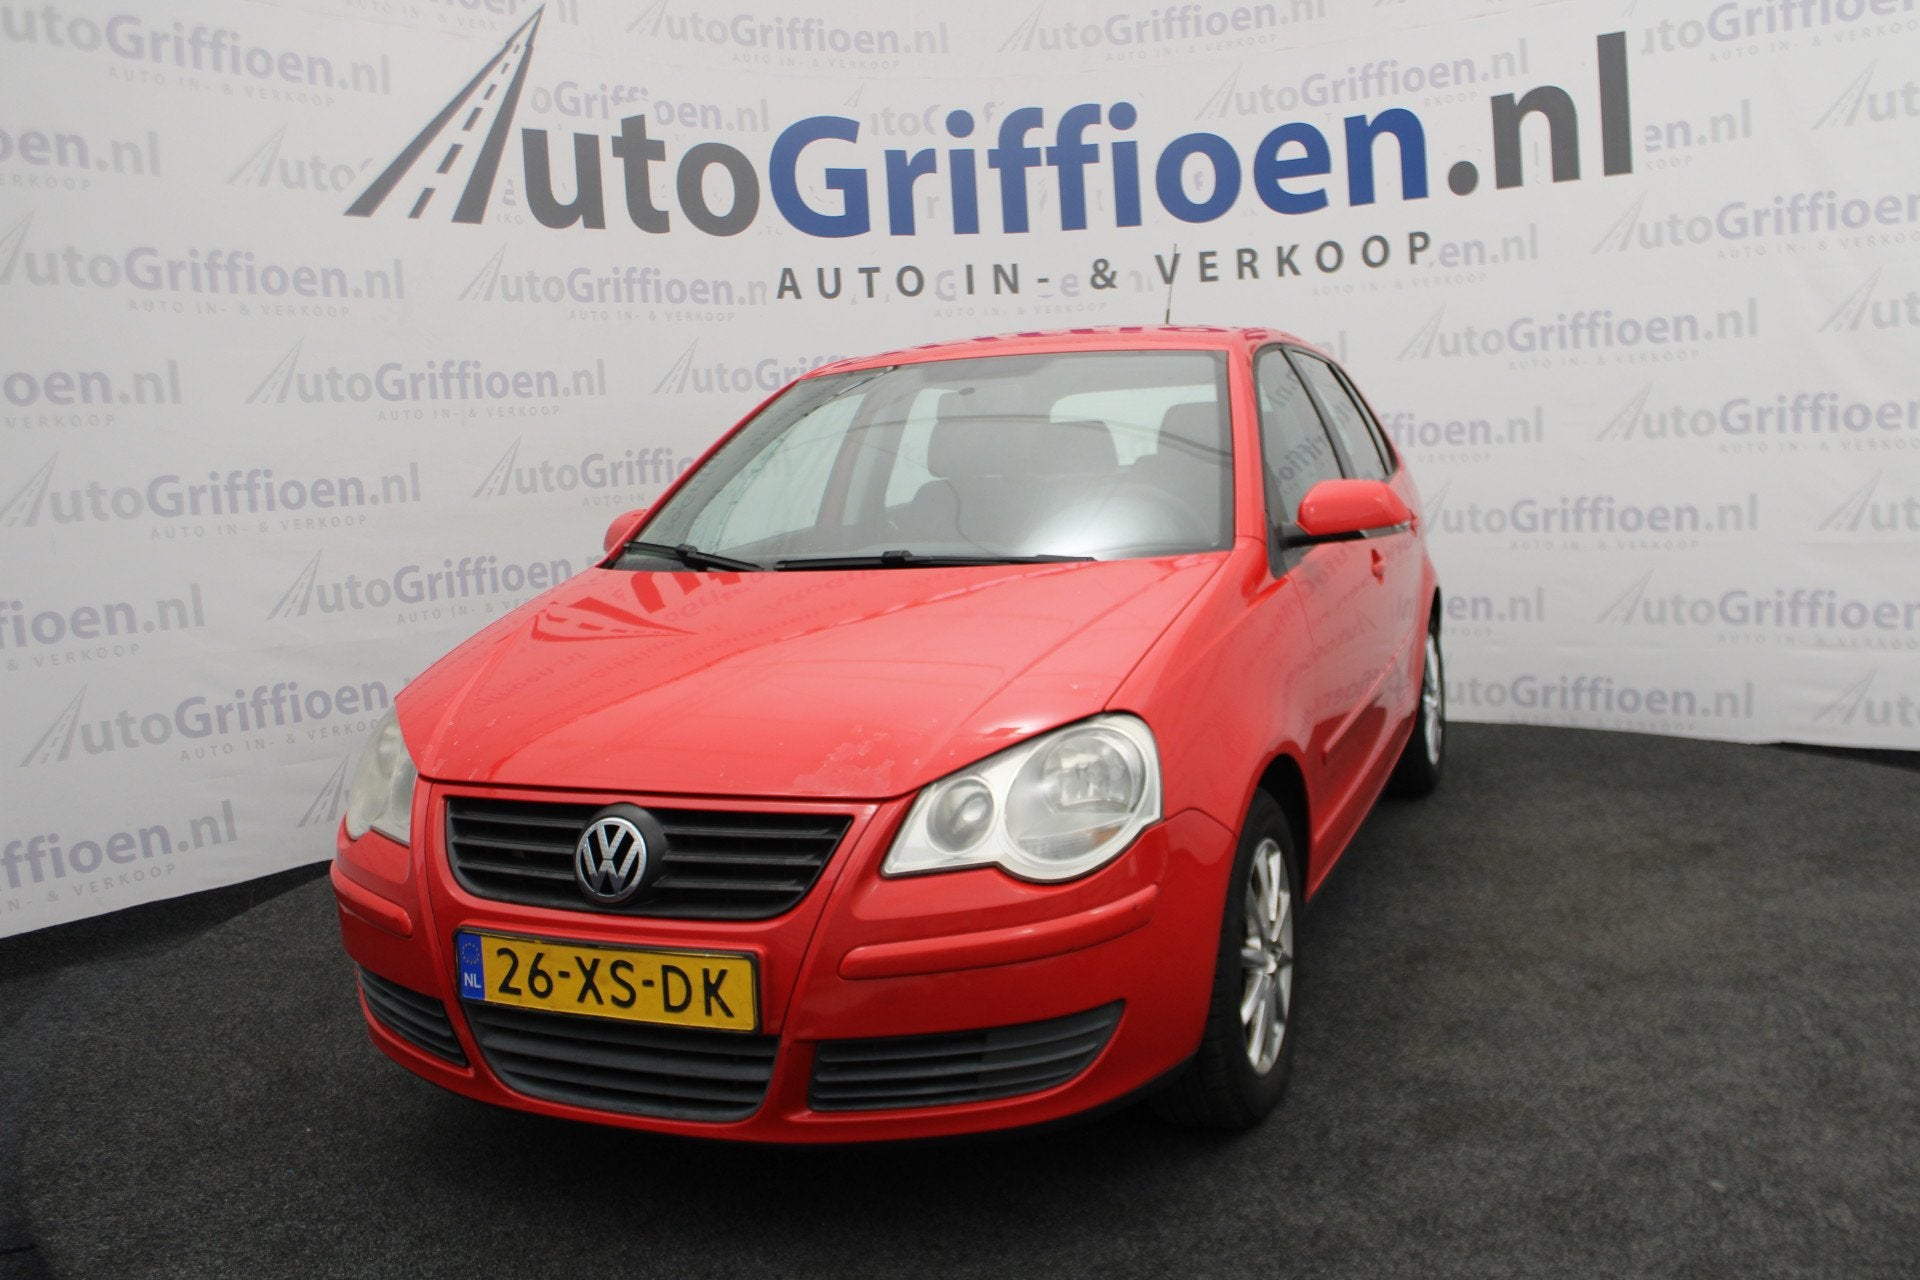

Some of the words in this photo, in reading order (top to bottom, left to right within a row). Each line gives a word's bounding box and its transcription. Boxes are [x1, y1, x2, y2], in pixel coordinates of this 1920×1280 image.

[226, 122, 373, 193] Auto
[343, 4, 1633, 239] AutoGriffioen.nl
[775, 264, 925, 299] AUTO
[965, 262, 1050, 295] IN-
[1089, 257, 1118, 290] &
[1154, 230, 1431, 286] VERKOOP
[1429, 223, 1538, 268] en.nl
[267, 547, 597, 621] AutoGriffioen
[20, 677, 411, 768] AutoGriffioen
[464, 972, 482, 989] NL
[496, 946, 735, 1019] 26-XS-DK
